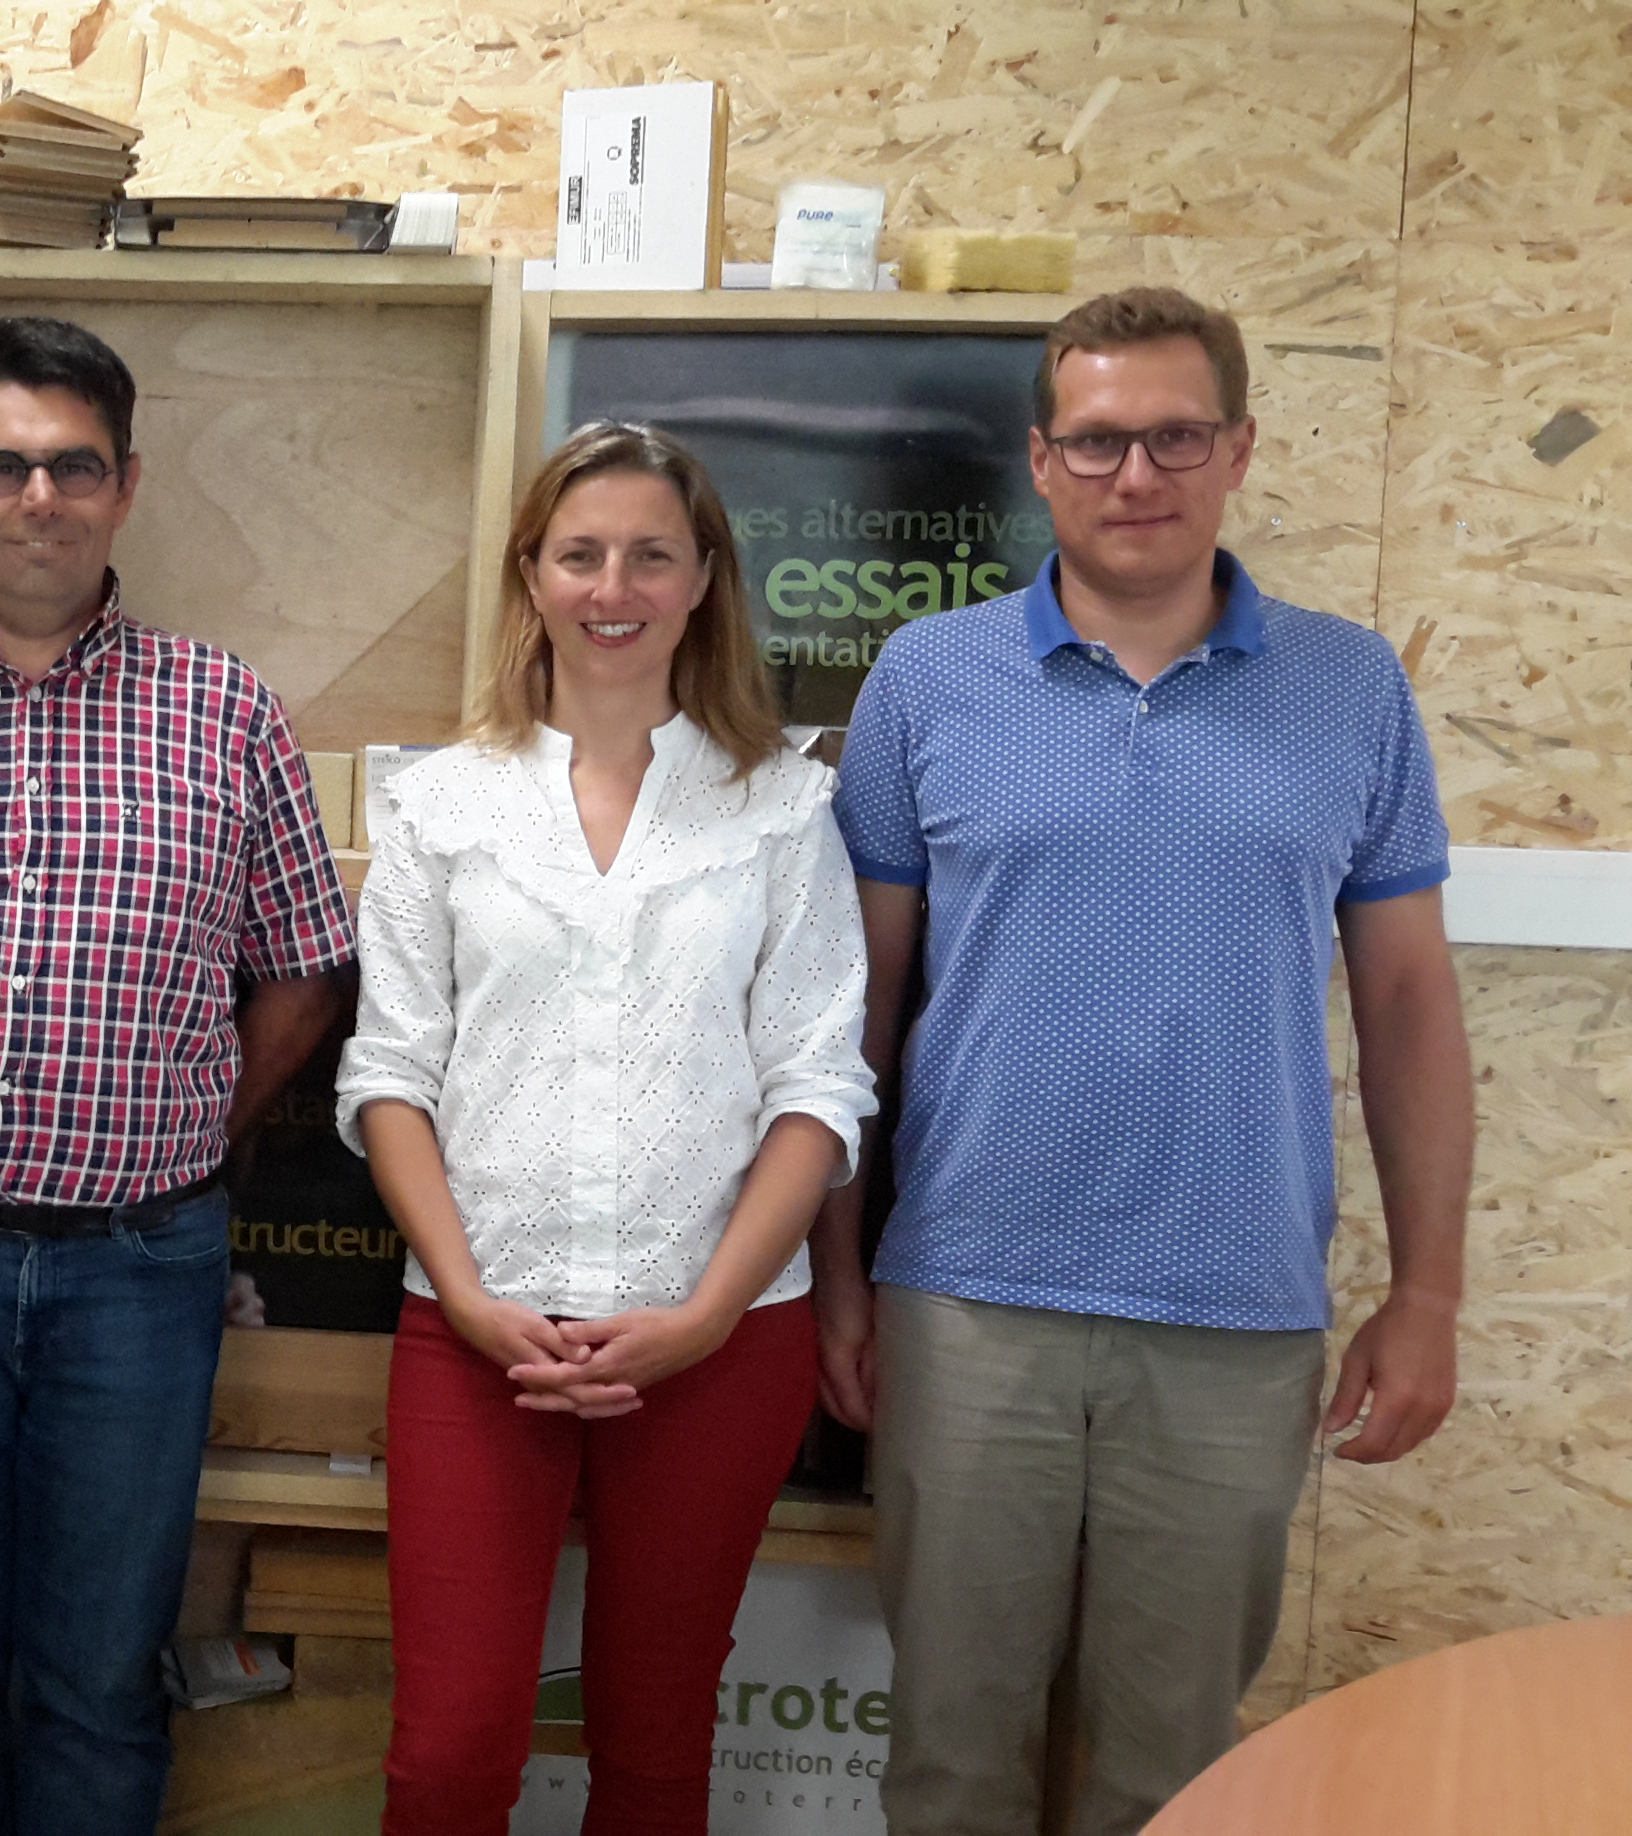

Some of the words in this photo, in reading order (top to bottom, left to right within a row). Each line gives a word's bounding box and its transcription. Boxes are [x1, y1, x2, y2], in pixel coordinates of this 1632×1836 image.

[629, 116, 642, 185] SOPREMA
[729, 507, 790, 539] ues
[801, 499, 1056, 543] alternatives
[766, 543, 1010, 620] essais
[229, 1215, 405, 1259] tructeur
[718, 1677, 894, 1736] rote
[845, 1750, 886, 1779] éc
